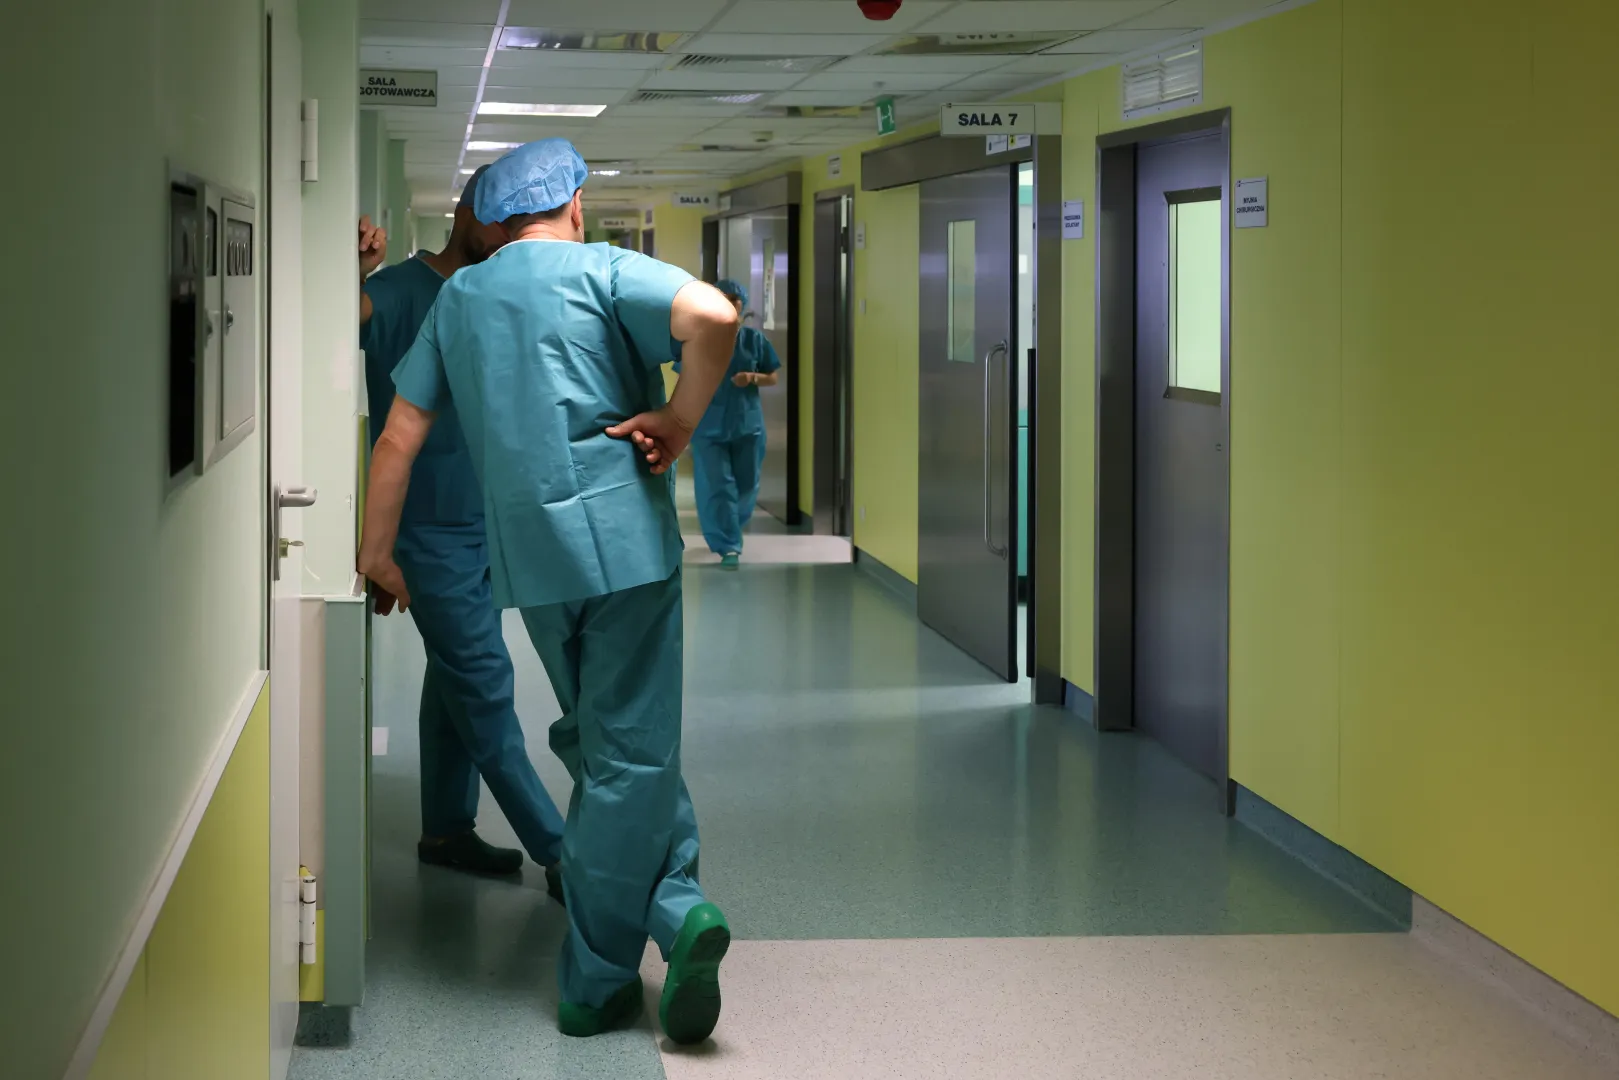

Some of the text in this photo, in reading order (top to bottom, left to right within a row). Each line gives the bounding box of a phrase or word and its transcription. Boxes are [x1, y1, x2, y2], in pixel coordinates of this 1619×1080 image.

[368, 76, 396, 86] SALA
[958, 112, 1018, 127] SALA 7
[680, 196, 701, 204] SALA
